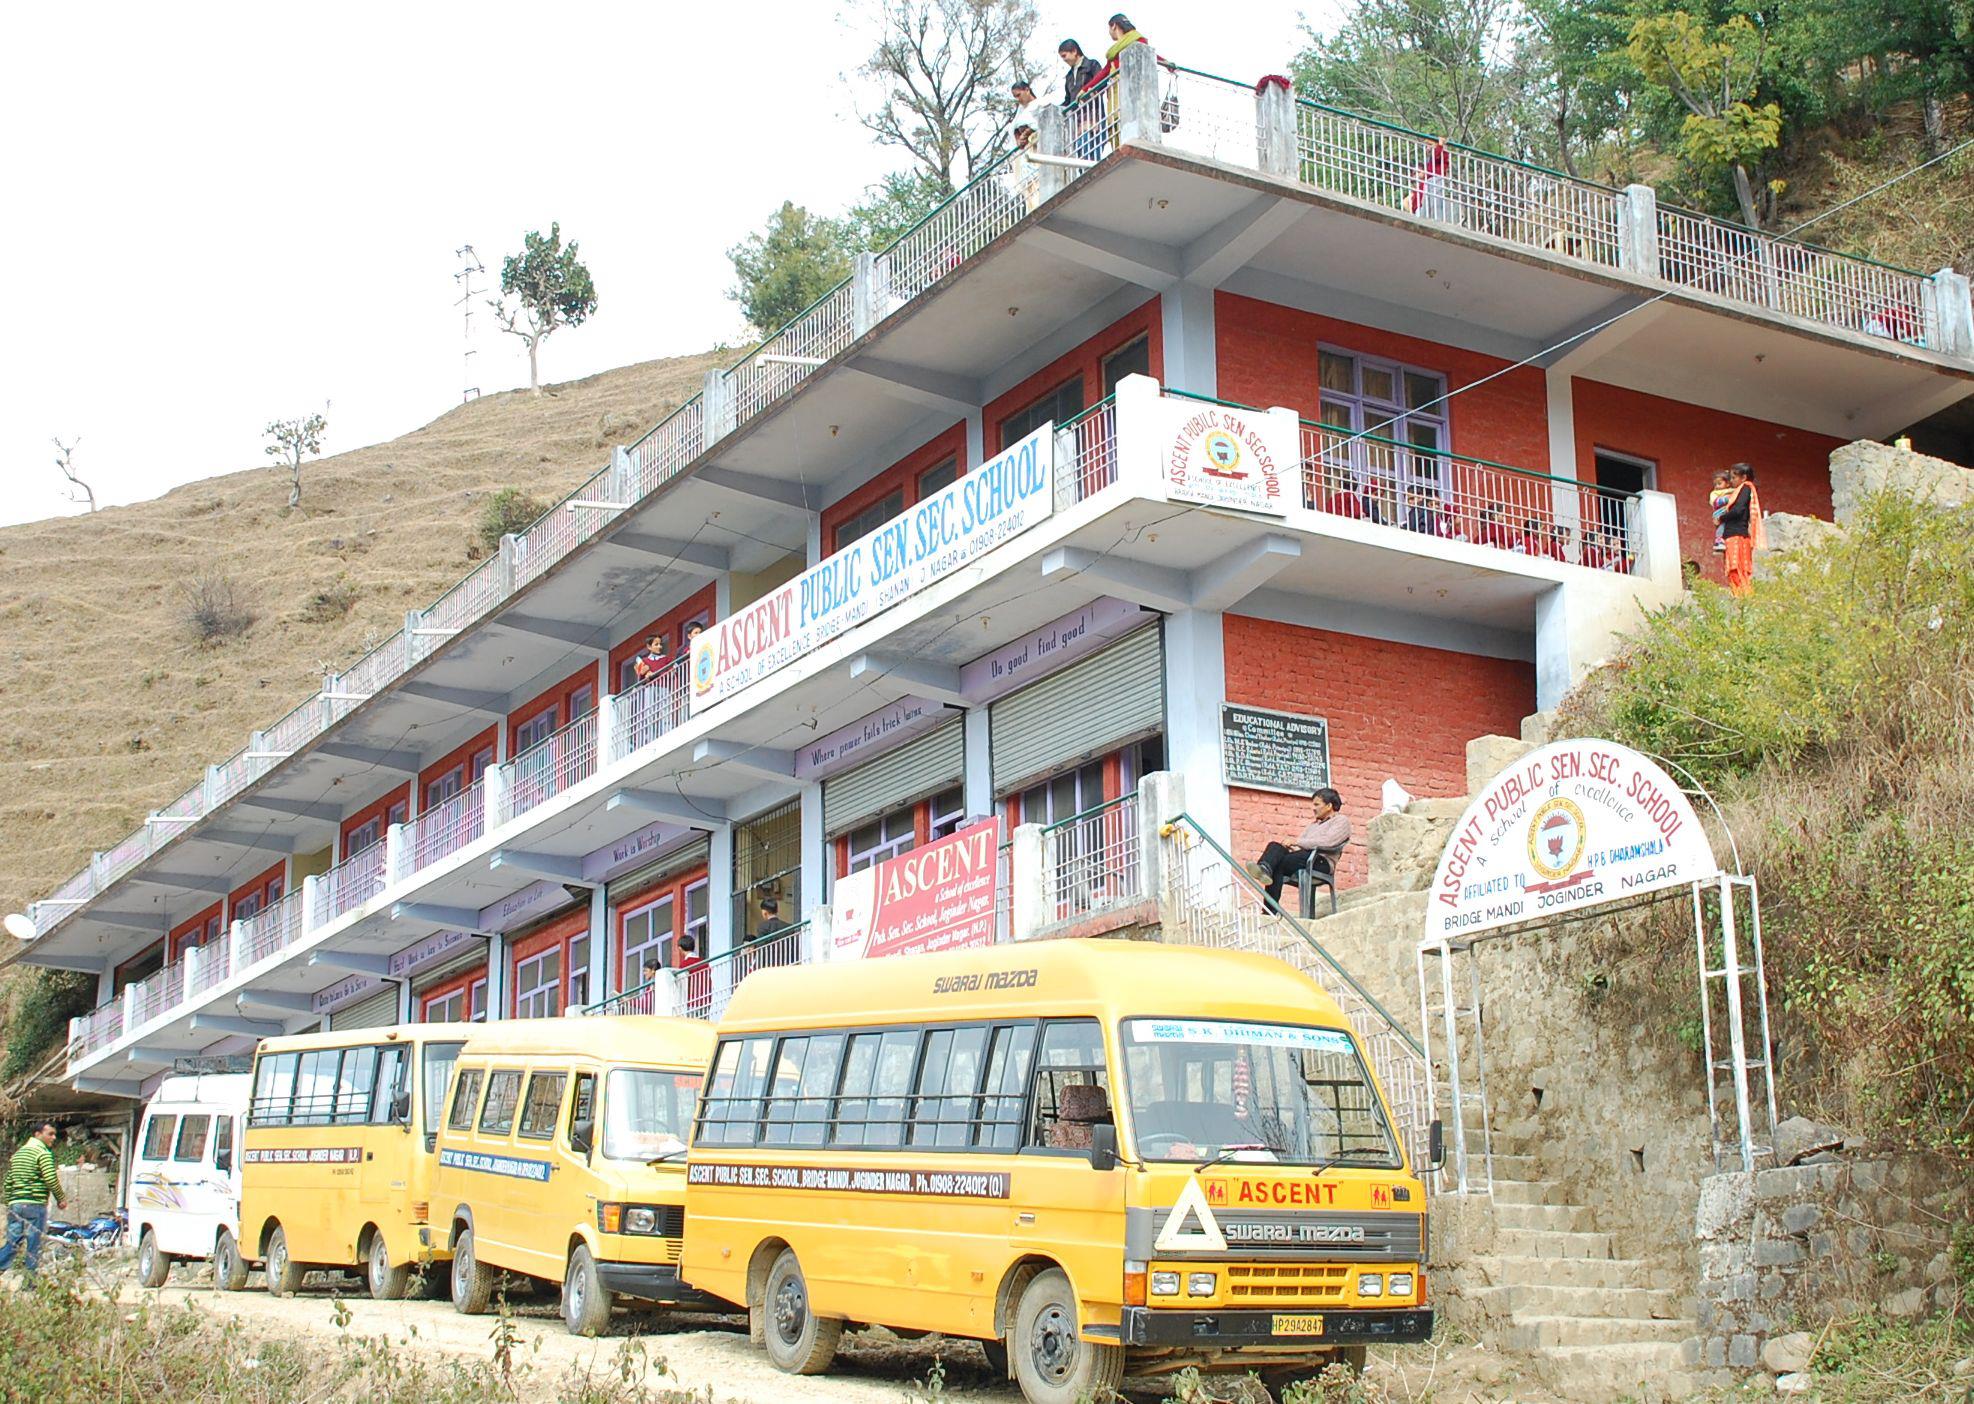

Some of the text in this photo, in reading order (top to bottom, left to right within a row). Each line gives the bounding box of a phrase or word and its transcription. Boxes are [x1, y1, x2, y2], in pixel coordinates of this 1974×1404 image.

[1170, 434, 1191, 486] ASCENT
[715, 587, 792, 676] ASCENT
[800, 547, 861, 629] PUBLIC
[962, 437, 1046, 535] SCHOOL
[726, 668, 753, 692] SCHOOL
[757, 659, 765, 676] OF
[768, 632, 811, 670] EXCELLENCE
[930, 550, 958, 577] NAGAR
[1008, 645, 1028, 675] good
[1062, 615, 1085, 649] good
[840, 737, 862, 759] power
[1232, 712, 1323, 736] EDUCATIONAL ADVISORY
[1439, 815, 1484, 908] ASCENT
[1484, 762, 1544, 822] PUBLIC
[1626, 771, 1683, 847] SCHOOL
[1490, 800, 1527, 847] school
[1549, 780, 1561, 798] of
[883, 828, 993, 905] ASCENT
[1444, 863, 1678, 930] BRIDGE MANDI JOGINDER NAGAR
[1464, 876, 1509, 901] AFFILIATED
[1514, 872, 1526, 889] TO
[689, 1164, 714, 1183] ASCENT
[715, 1165, 738, 1184] PUBLIC
[851, 1171, 885, 1191] JOGINDER
[1272, 1316, 1323, 1334] HP29A2847
